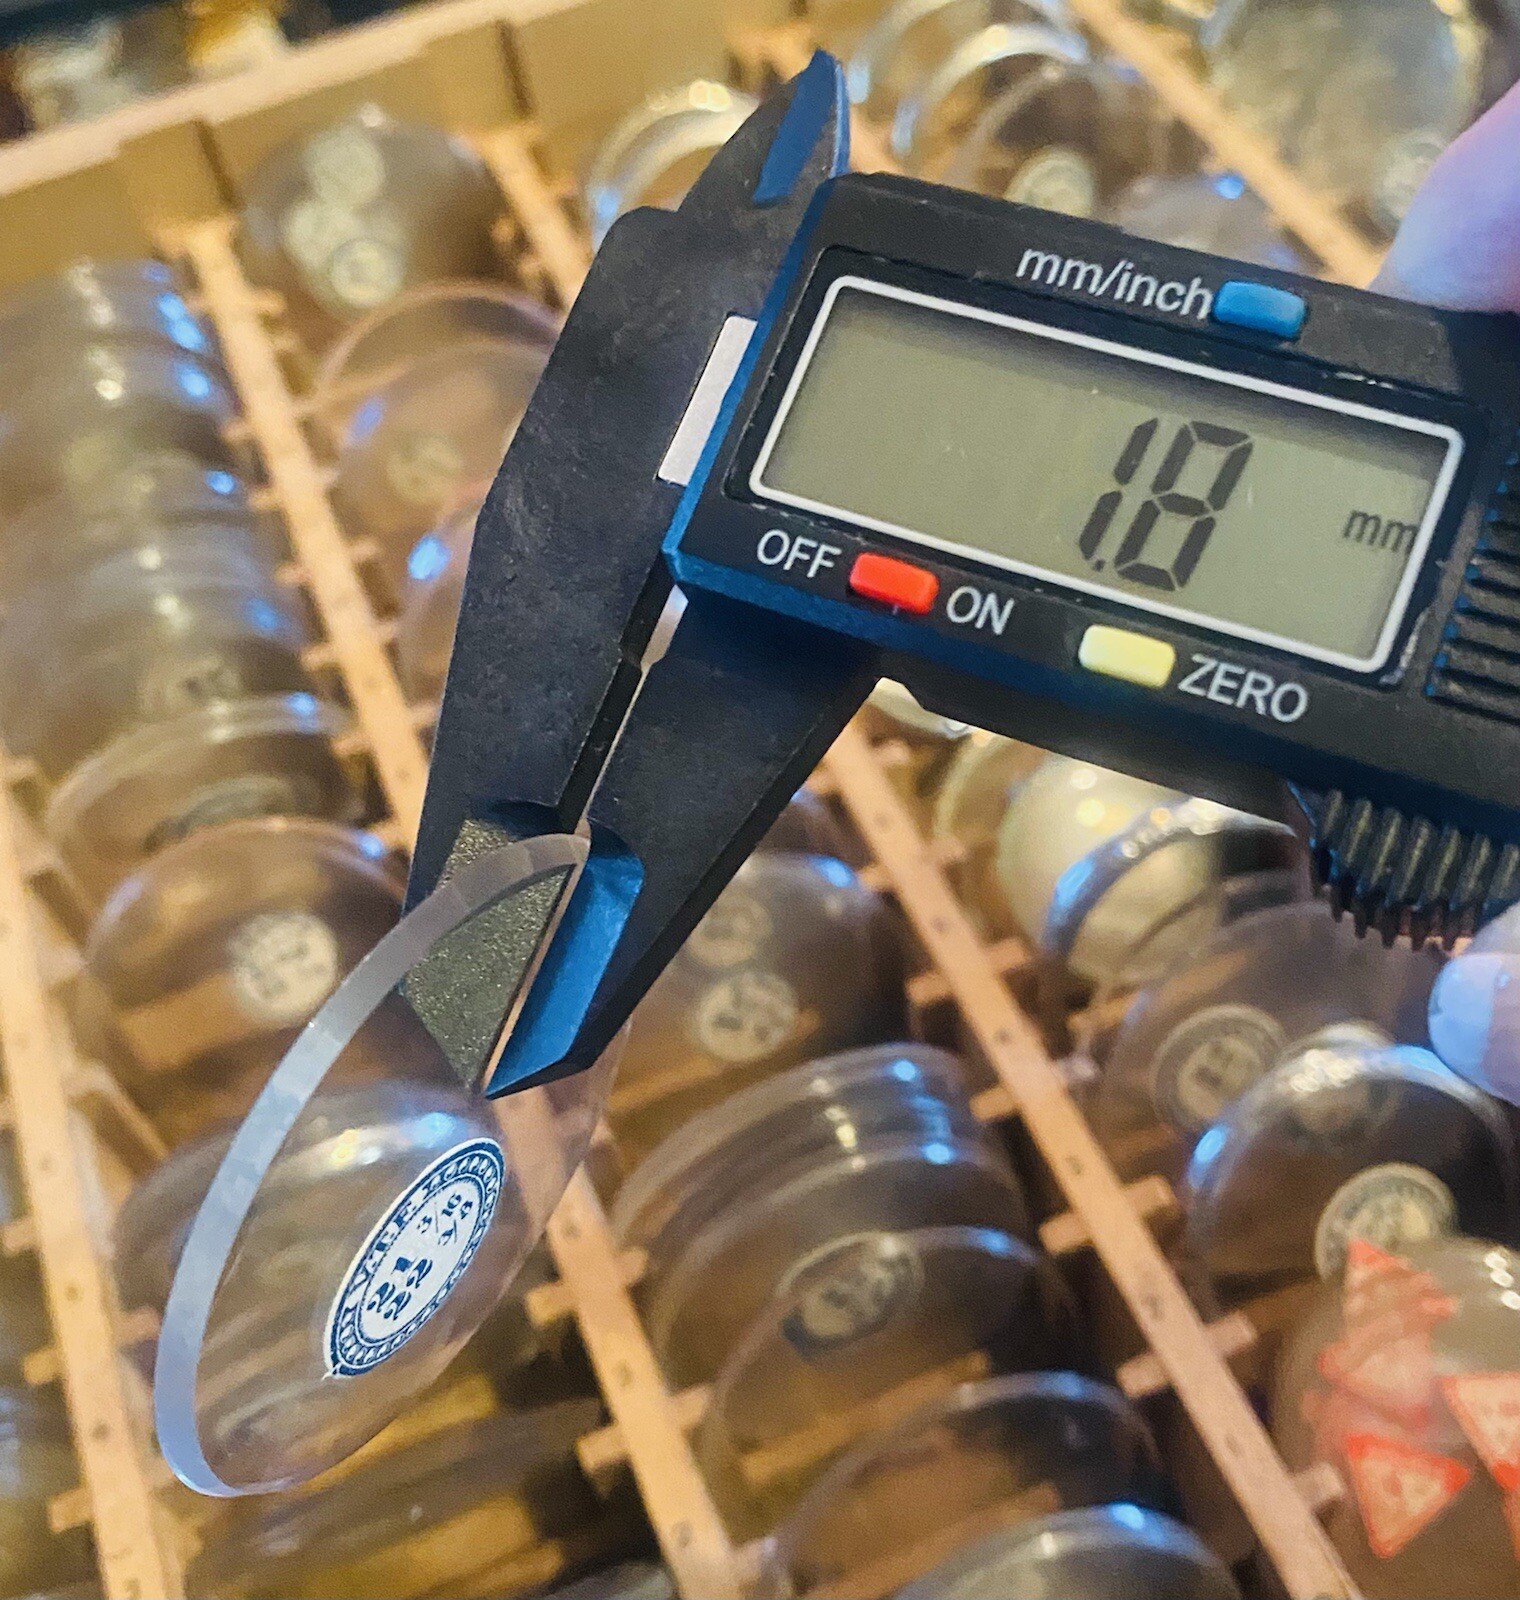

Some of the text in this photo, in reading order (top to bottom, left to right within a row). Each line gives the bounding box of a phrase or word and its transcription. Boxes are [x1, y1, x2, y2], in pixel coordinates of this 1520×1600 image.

[1017, 248, 1214, 319] mm/inch
[1079, 418, 1419, 591] 1.8 mm
[757, 529, 841, 578] OFF
[946, 587, 1014, 635] ON
[1178, 654, 1307, 723] ZERO
[384, 1259, 433, 1320] 22
